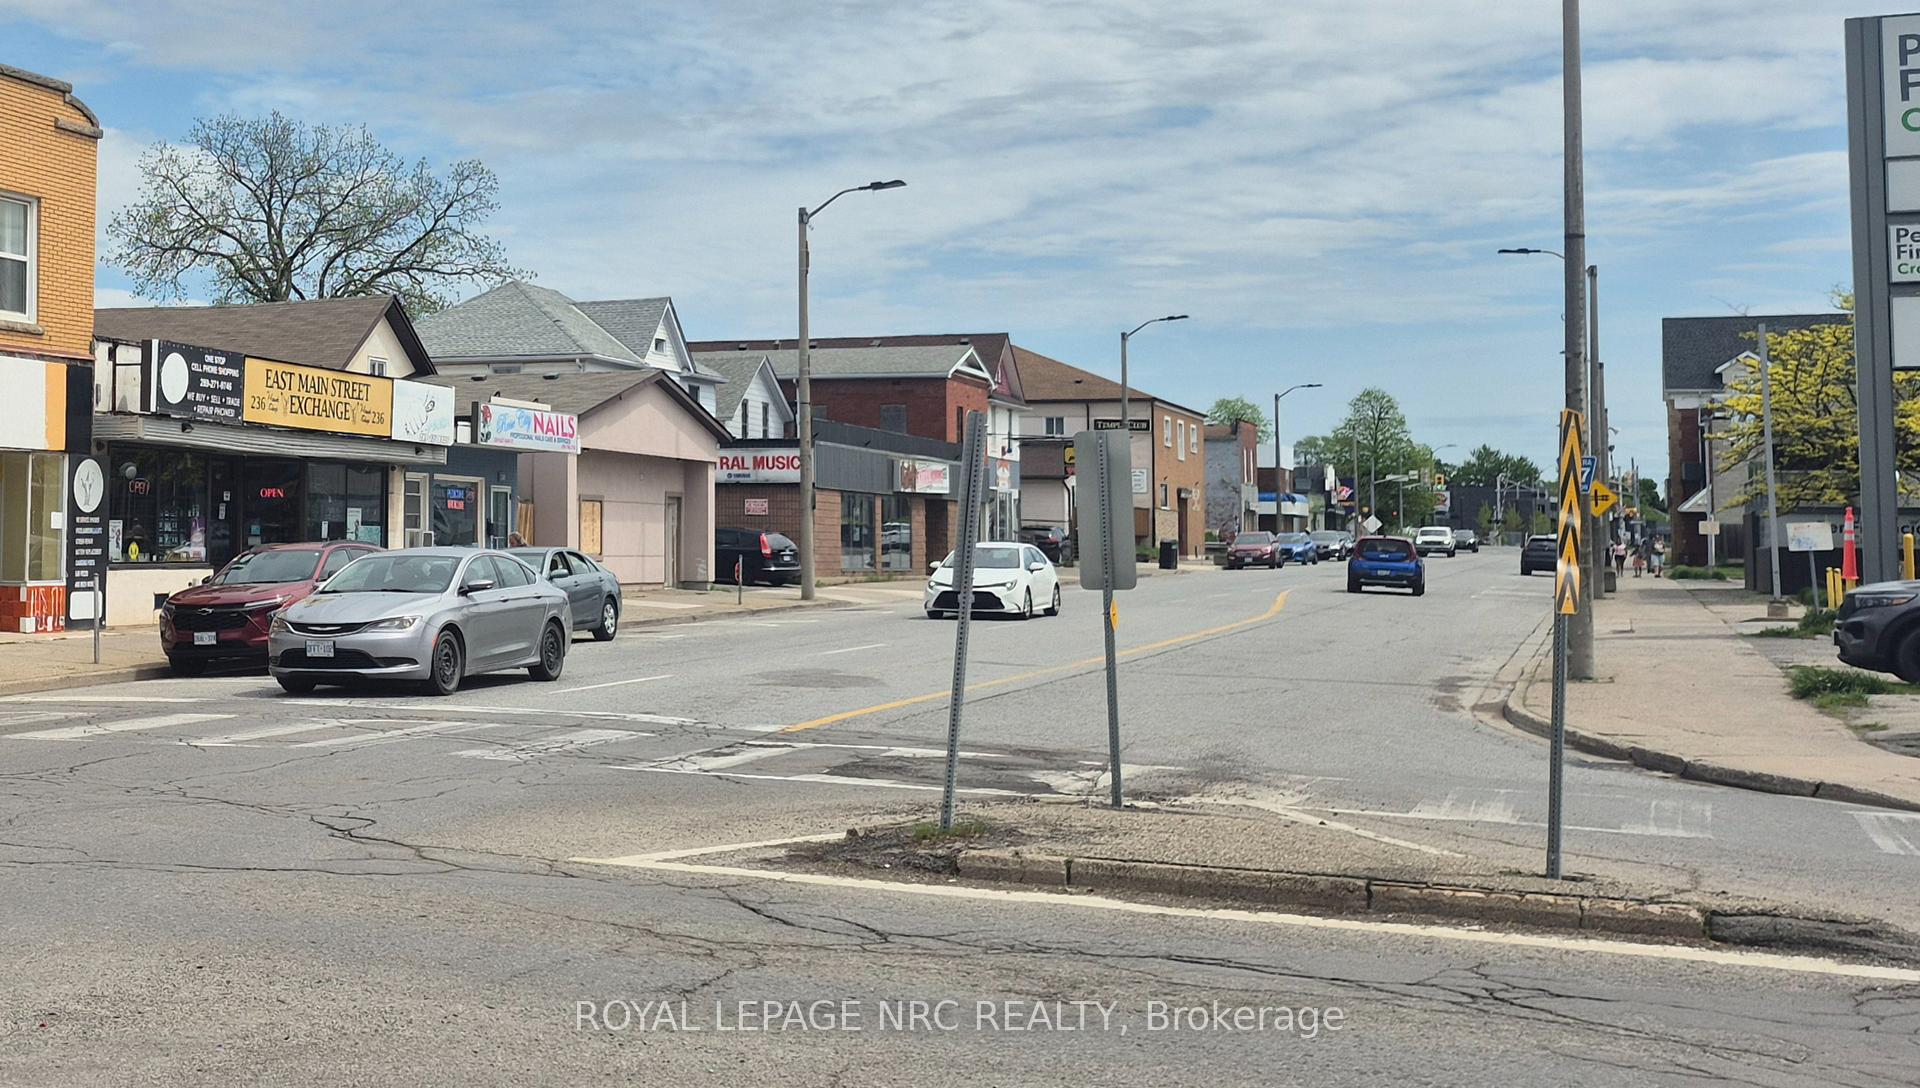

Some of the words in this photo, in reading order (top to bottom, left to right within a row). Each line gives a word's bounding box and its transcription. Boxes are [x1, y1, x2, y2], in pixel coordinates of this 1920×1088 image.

[191, 362, 202, 372] CELL
[203, 365, 217, 374] PHONE
[265, 369, 295, 391] EAST
[298, 374, 328, 396] MAIN
[331, 379, 371, 401] STREET
[196, 393, 206, 402] BUY
[211, 395, 220, 404] SELL
[226, 397, 240, 407] TRADE
[251, 395, 266, 410] 236
[197, 405, 213, 414] REPAIR
[290, 395, 351, 420] EXCHANGE
[372, 411, 385, 424] 236
[534, 412, 575, 438] NAILS
[752, 456, 800, 470] MUSIC
[260, 488, 284, 498] OPEN
